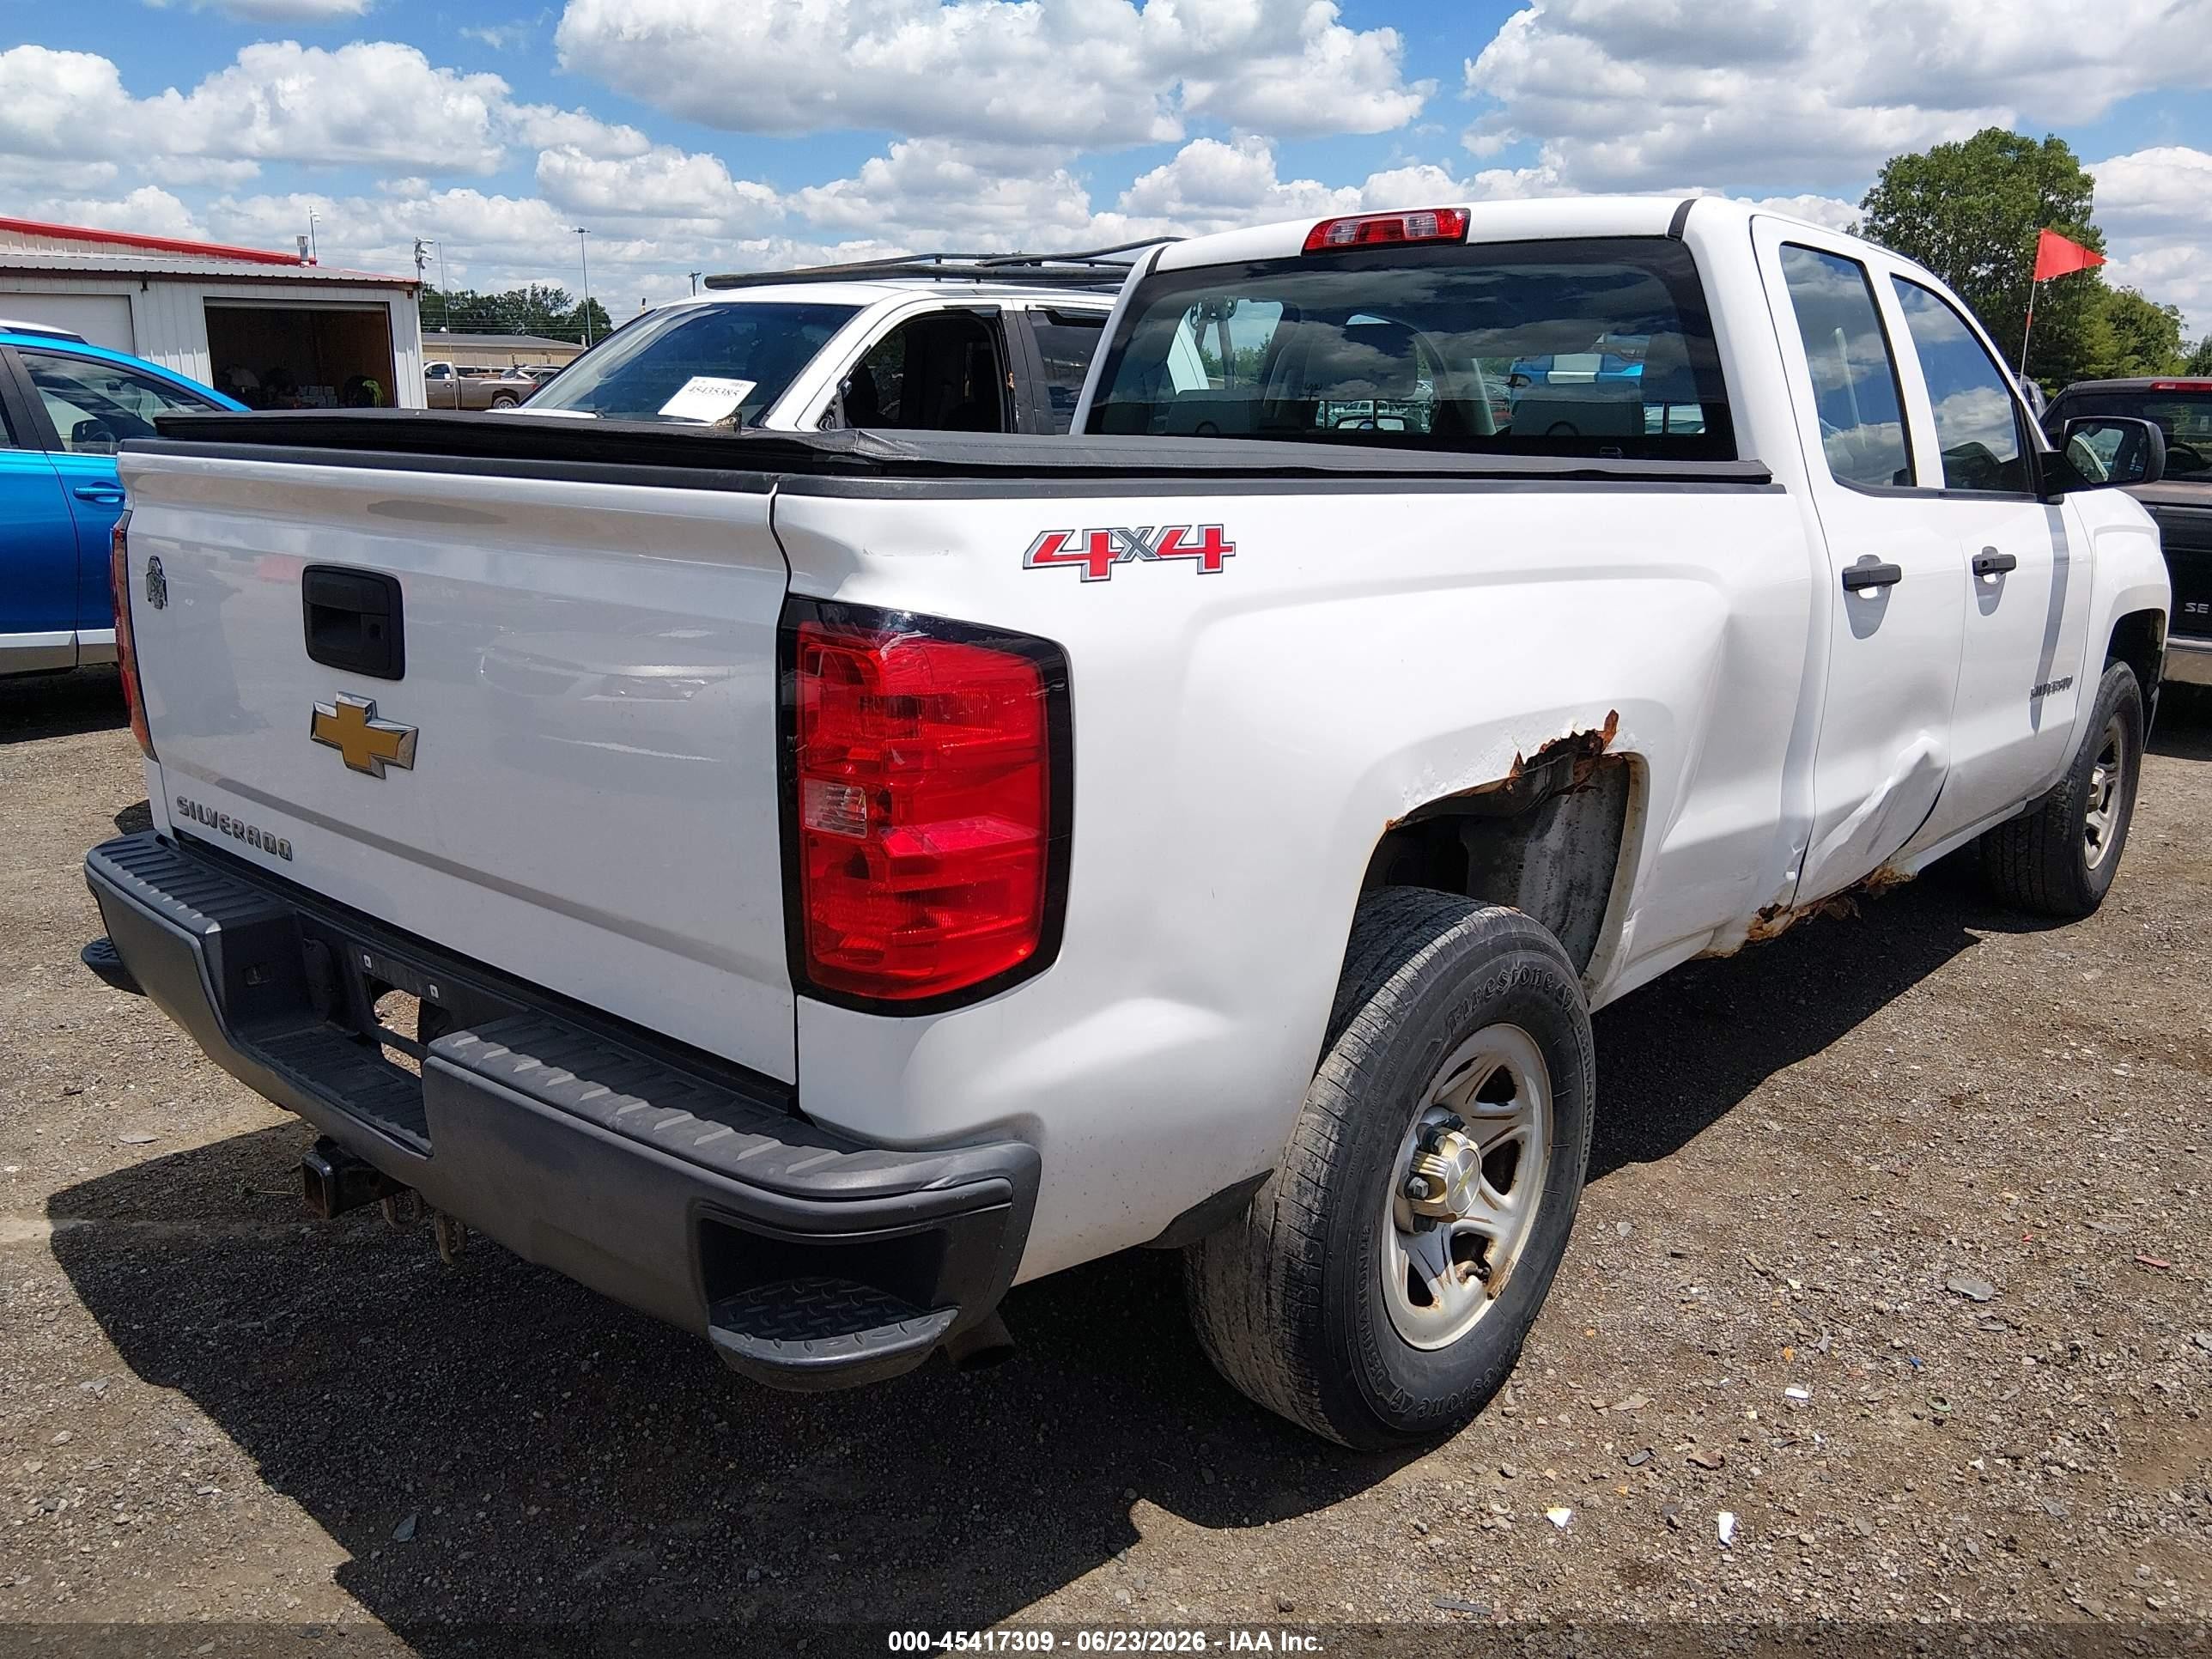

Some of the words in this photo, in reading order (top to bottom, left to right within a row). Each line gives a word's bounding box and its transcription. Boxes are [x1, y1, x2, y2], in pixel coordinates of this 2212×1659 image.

[2184, 602, 2209, 614] SE
[177, 795, 293, 861] SILVERADO
[1445, 964, 1555, 1037] Firestone
